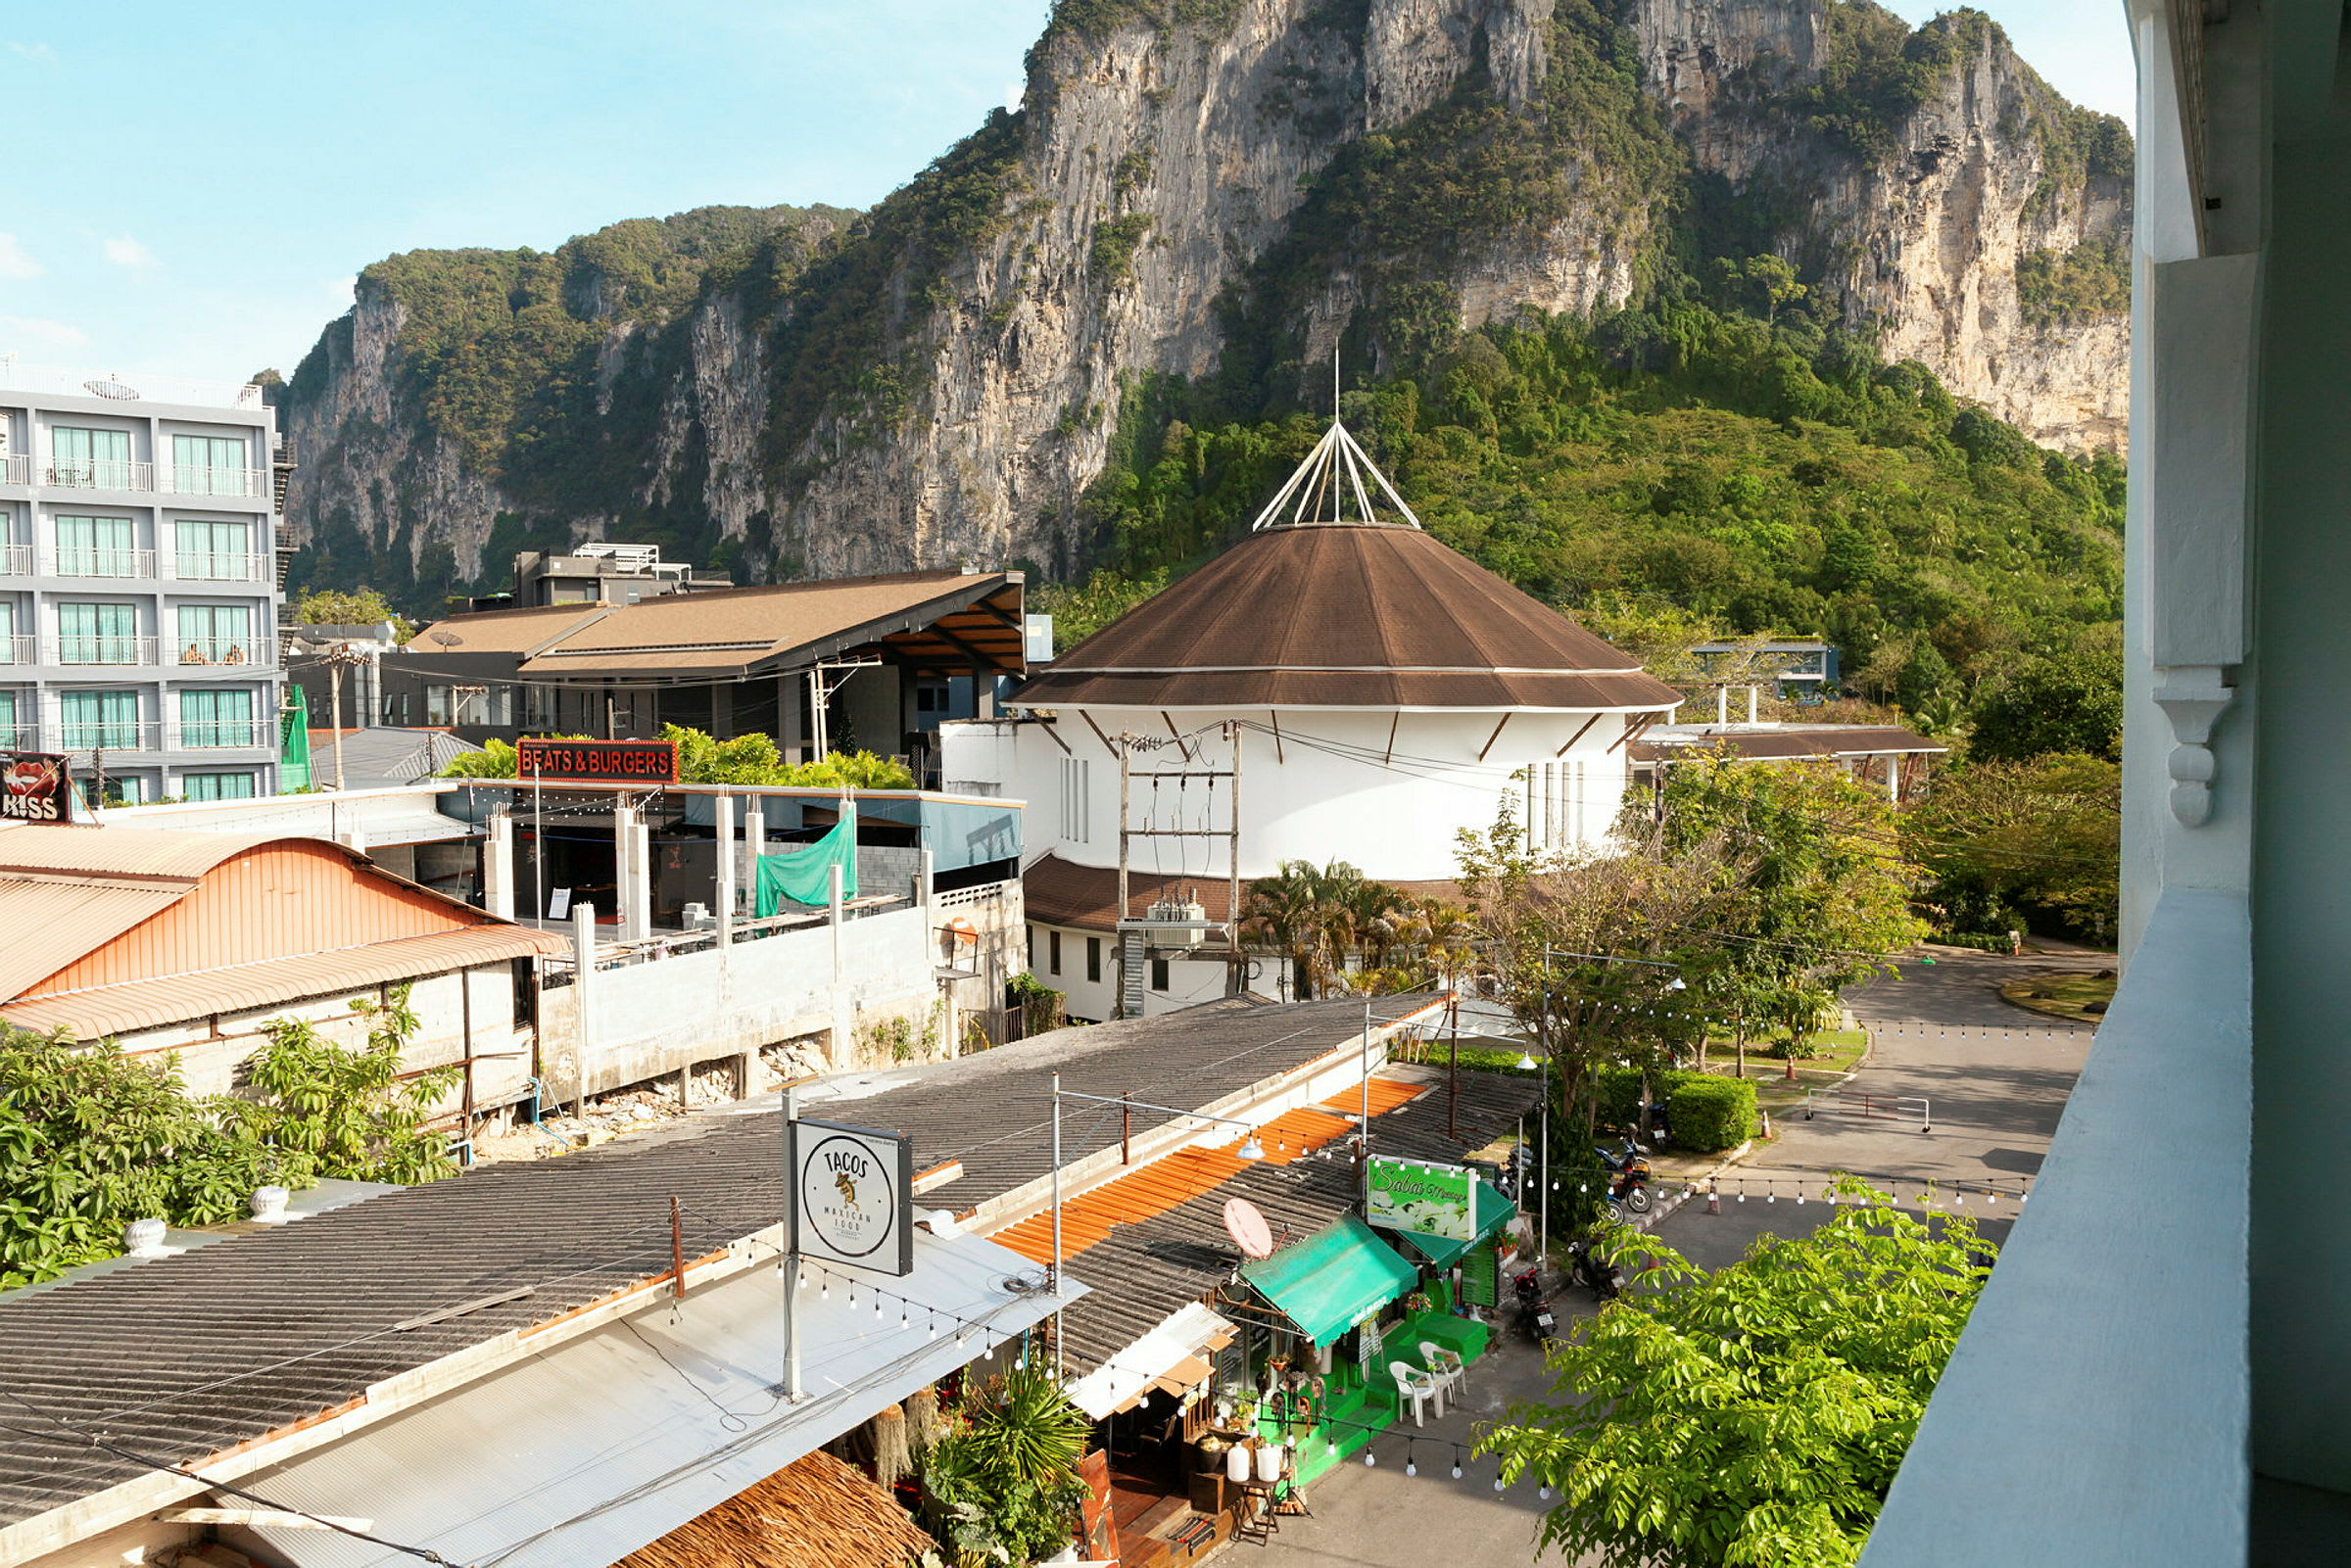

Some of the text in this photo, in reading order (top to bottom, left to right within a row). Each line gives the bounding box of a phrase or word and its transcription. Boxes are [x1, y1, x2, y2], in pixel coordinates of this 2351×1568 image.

[522, 749, 668, 774] BEATS & BURGERS
[824, 1152, 869, 1178] TACOS
[1372, 1165, 1423, 1195] Sabai
[835, 1218, 860, 1231] FOOD
